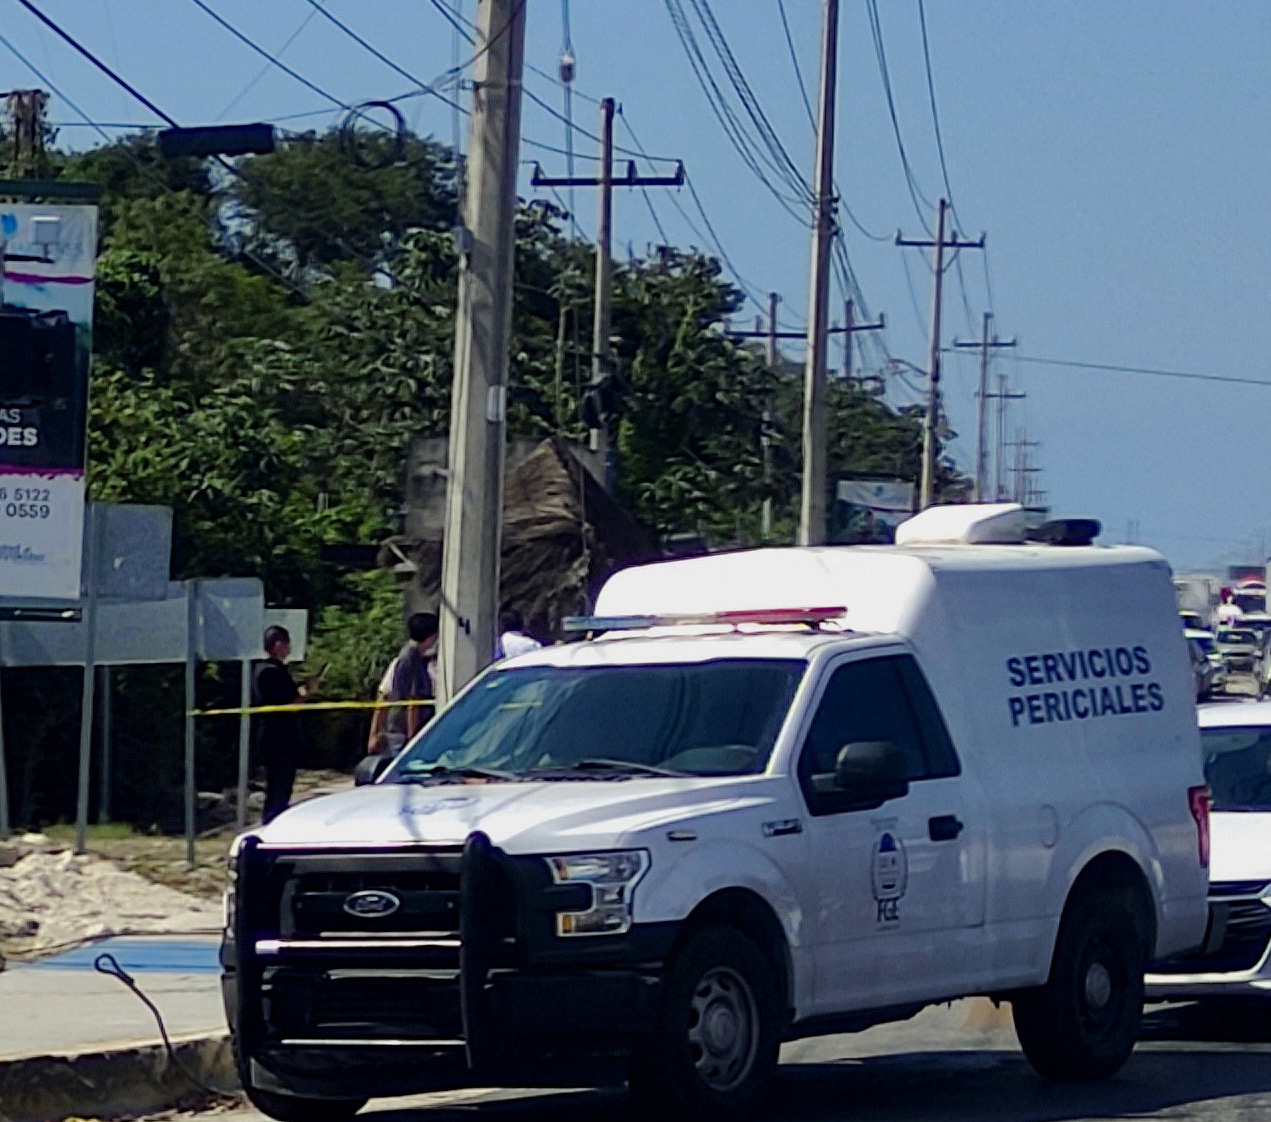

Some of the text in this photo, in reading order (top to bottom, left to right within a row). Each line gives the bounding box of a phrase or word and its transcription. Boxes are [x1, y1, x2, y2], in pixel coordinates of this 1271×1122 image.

[14, 488, 51, 502] 5122
[6, 502, 50, 519] 0559
[1007, 646, 1152, 687] SERVICIOS
[1008, 682, 1165, 728] PERICIALES
